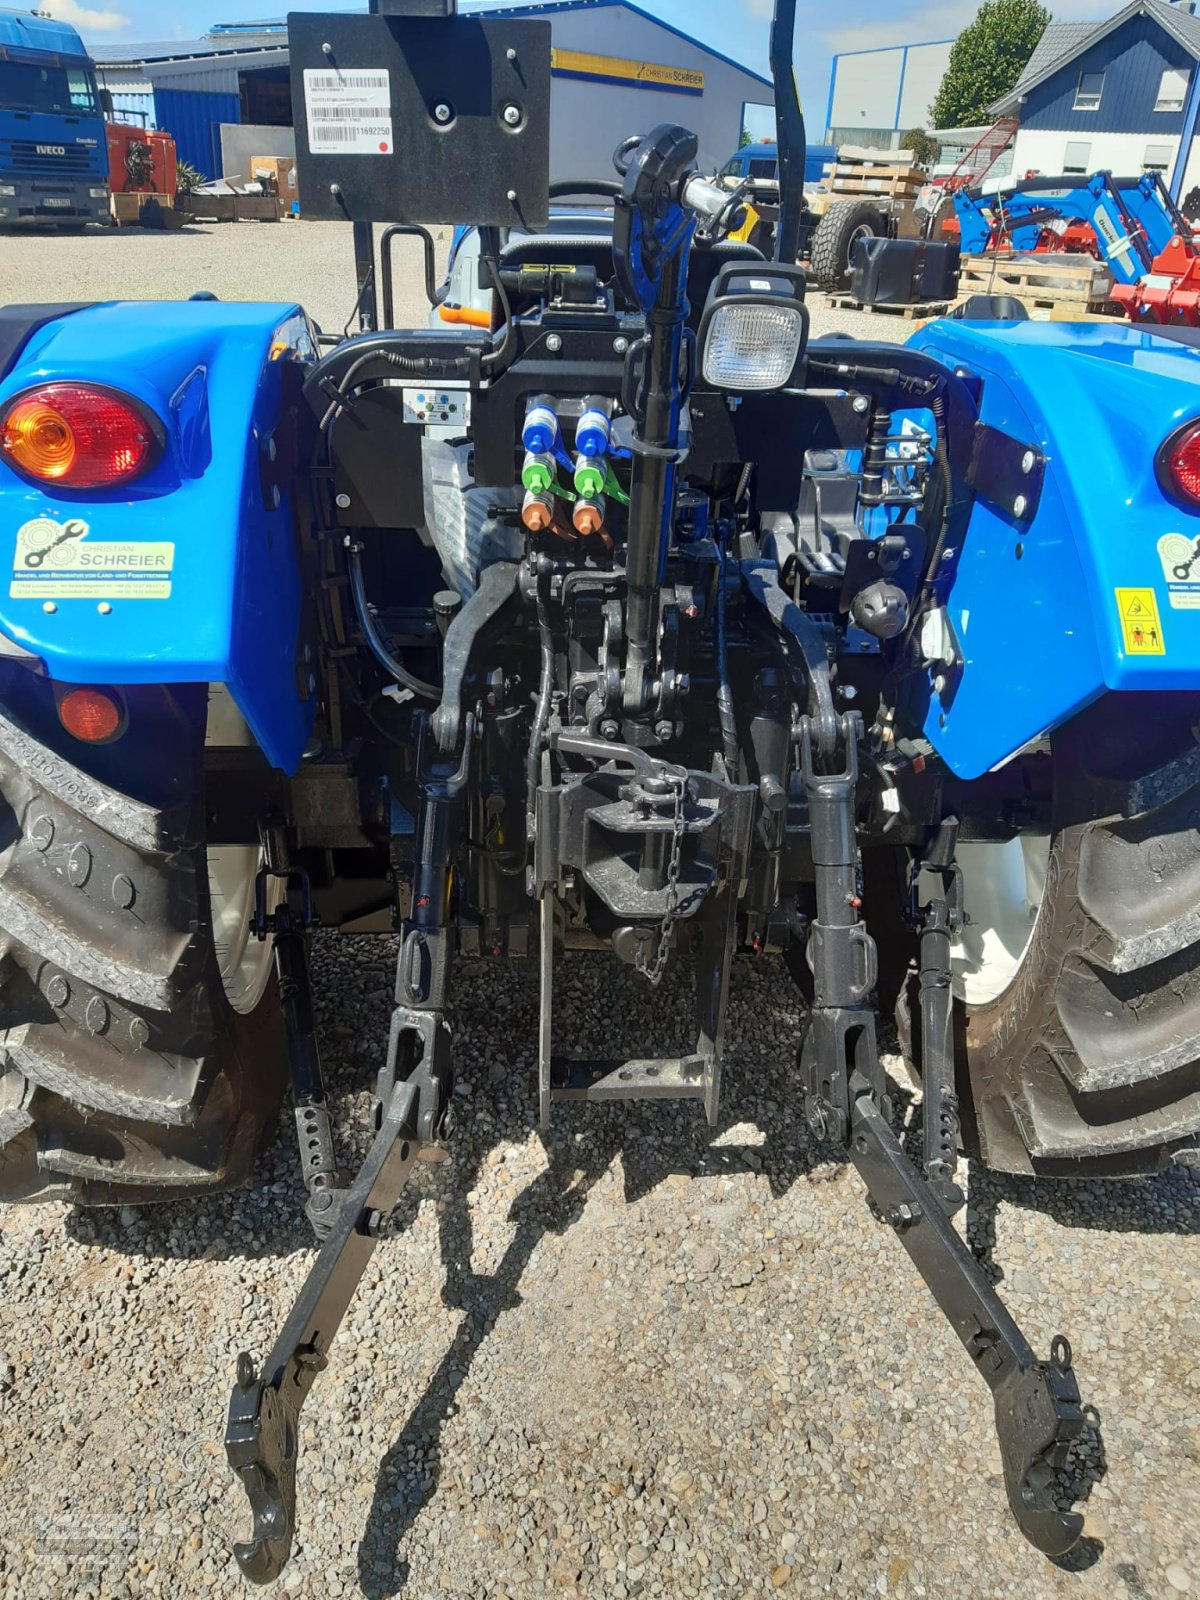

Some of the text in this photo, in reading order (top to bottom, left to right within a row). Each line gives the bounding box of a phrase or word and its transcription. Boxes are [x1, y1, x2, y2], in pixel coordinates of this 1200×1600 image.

[645, 69, 703, 84] CHRISTIAN SCHREIER
[356, 127, 390, 136] 11692250
[36, 145, 65, 155] IVECO
[81, 545, 134, 553] CHRISTIAN
[79, 553, 166, 566] SCHREIER
